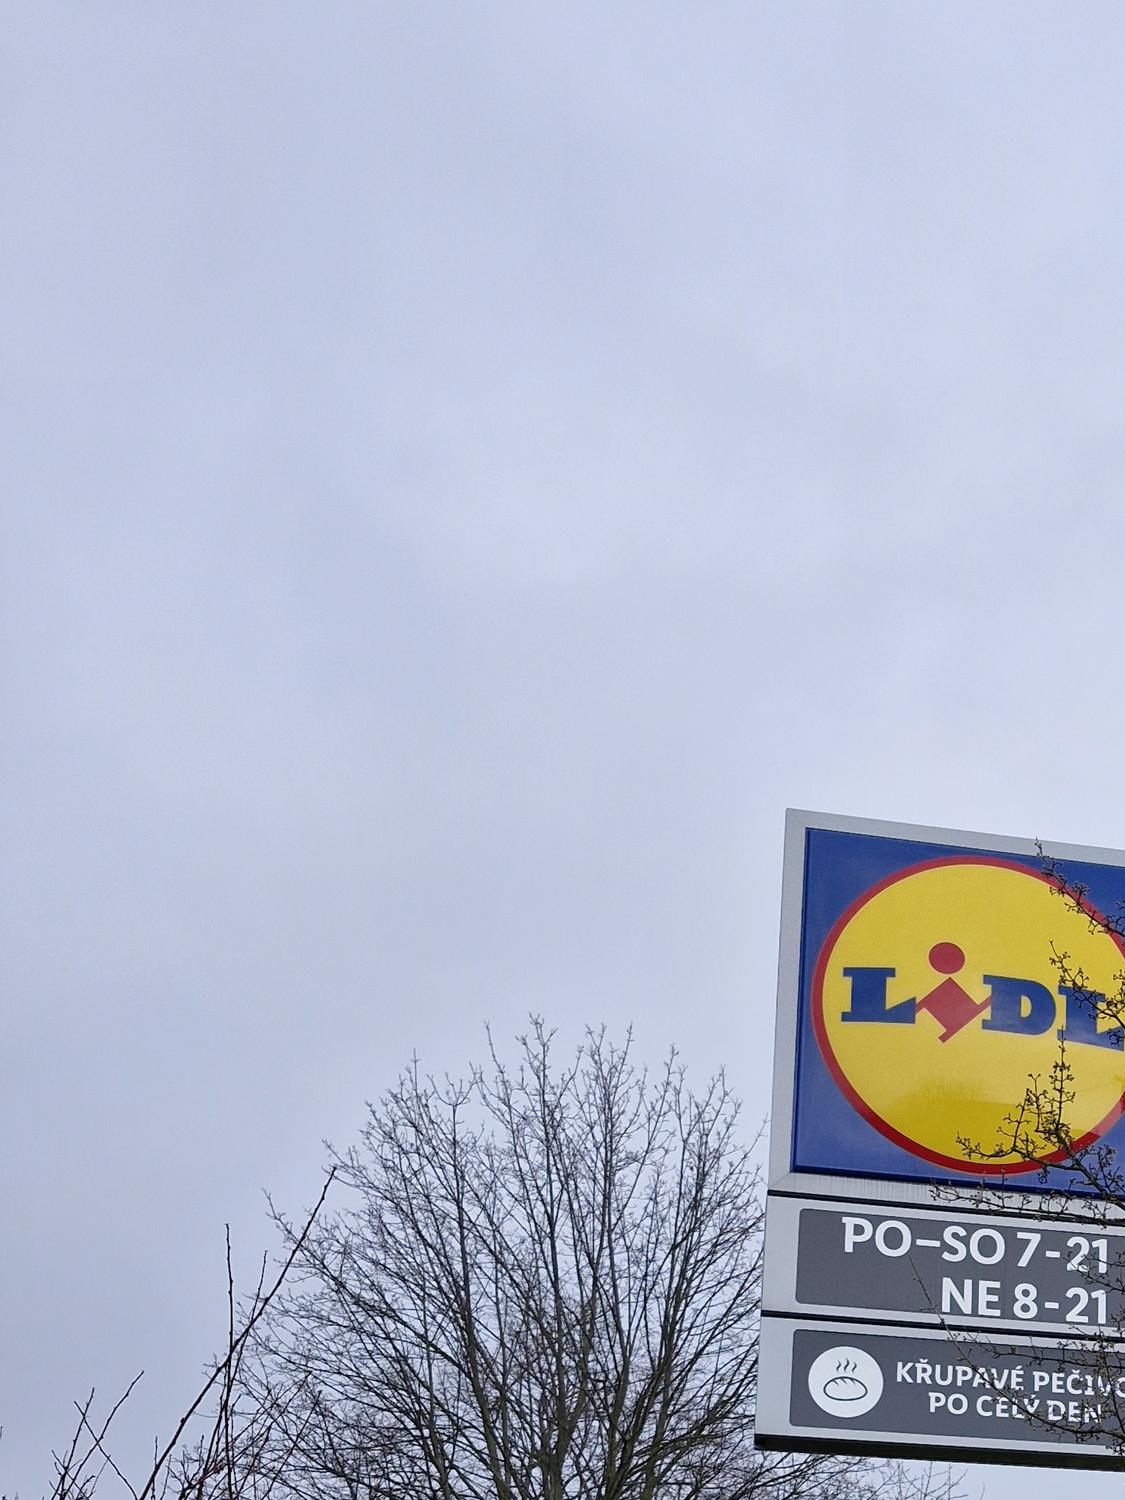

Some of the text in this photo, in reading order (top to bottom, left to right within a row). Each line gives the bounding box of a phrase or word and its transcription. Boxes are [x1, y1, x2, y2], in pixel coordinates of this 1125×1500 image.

[1016, 1231, 1108, 1274] 7-21
[941, 1277, 1108, 1325] NE 8-21
[896, 1358, 1025, 1391] KŘUPAVÉ
[928, 1392, 969, 1416] PO
[1047, 1400, 1102, 1424] DEN
